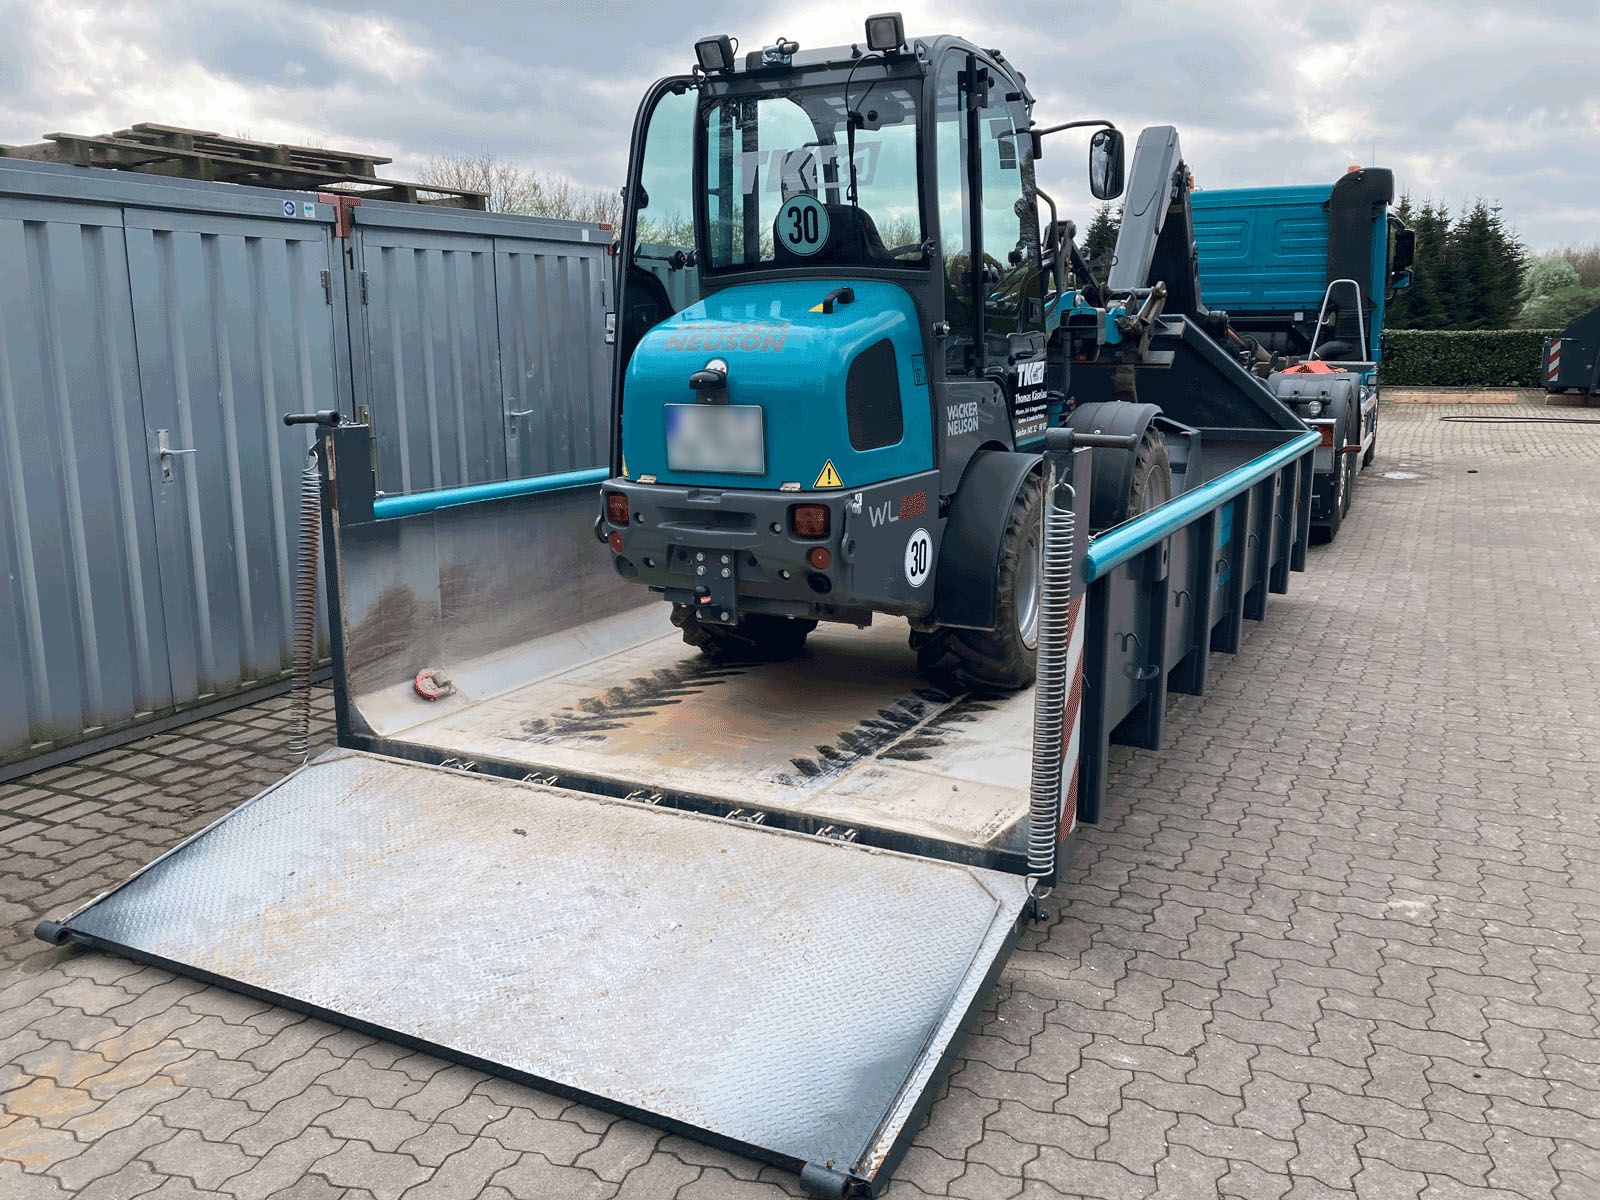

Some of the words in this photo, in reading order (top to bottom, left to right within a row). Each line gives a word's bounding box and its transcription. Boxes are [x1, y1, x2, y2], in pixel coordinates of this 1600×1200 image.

[787, 205, 819, 244] 30
[665, 333, 786, 353] NEUSON
[1015, 393, 1032, 404] Thomas
[947, 402, 978, 420] WACKER
[947, 416, 979, 437] NEUSON
[911, 539, 927, 577] 30
